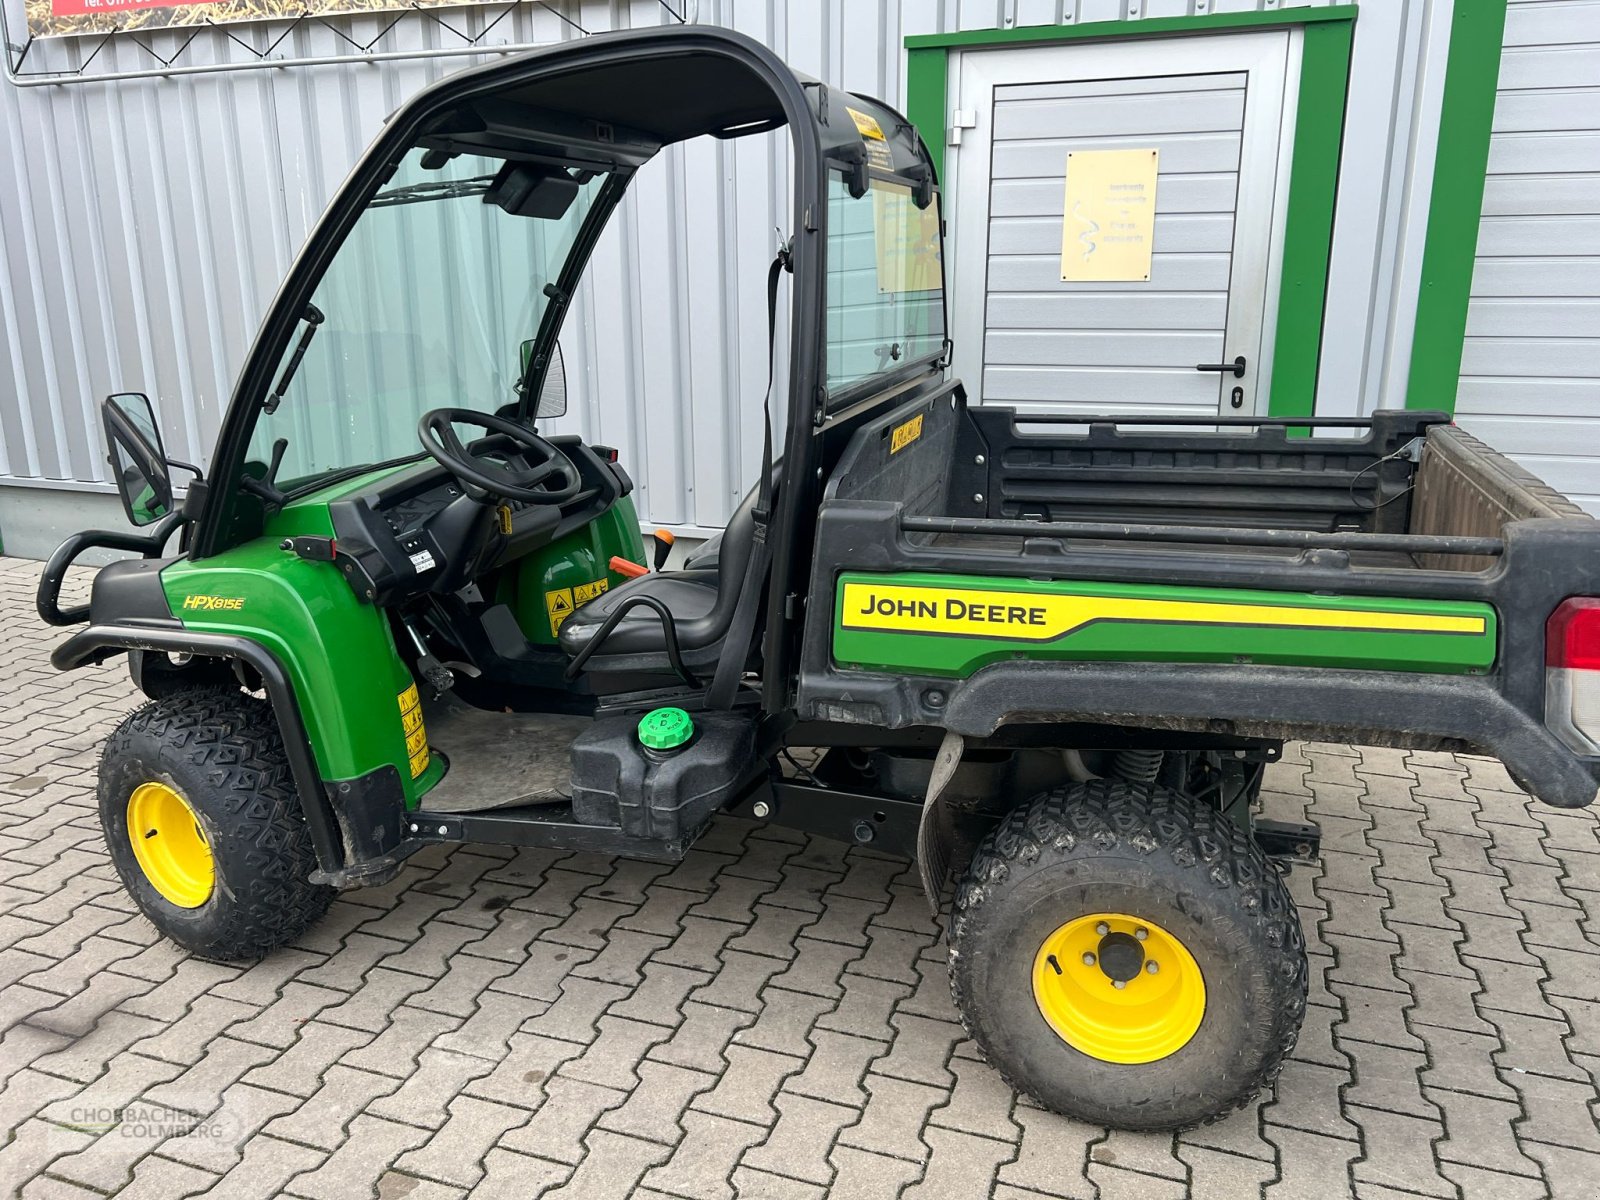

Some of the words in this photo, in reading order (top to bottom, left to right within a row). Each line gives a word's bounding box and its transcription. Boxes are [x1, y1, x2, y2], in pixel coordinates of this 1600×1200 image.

[183, 595, 245, 610] HPX815E
[860, 594, 937, 619] JOHN
[945, 599, 1047, 626] DEERE
